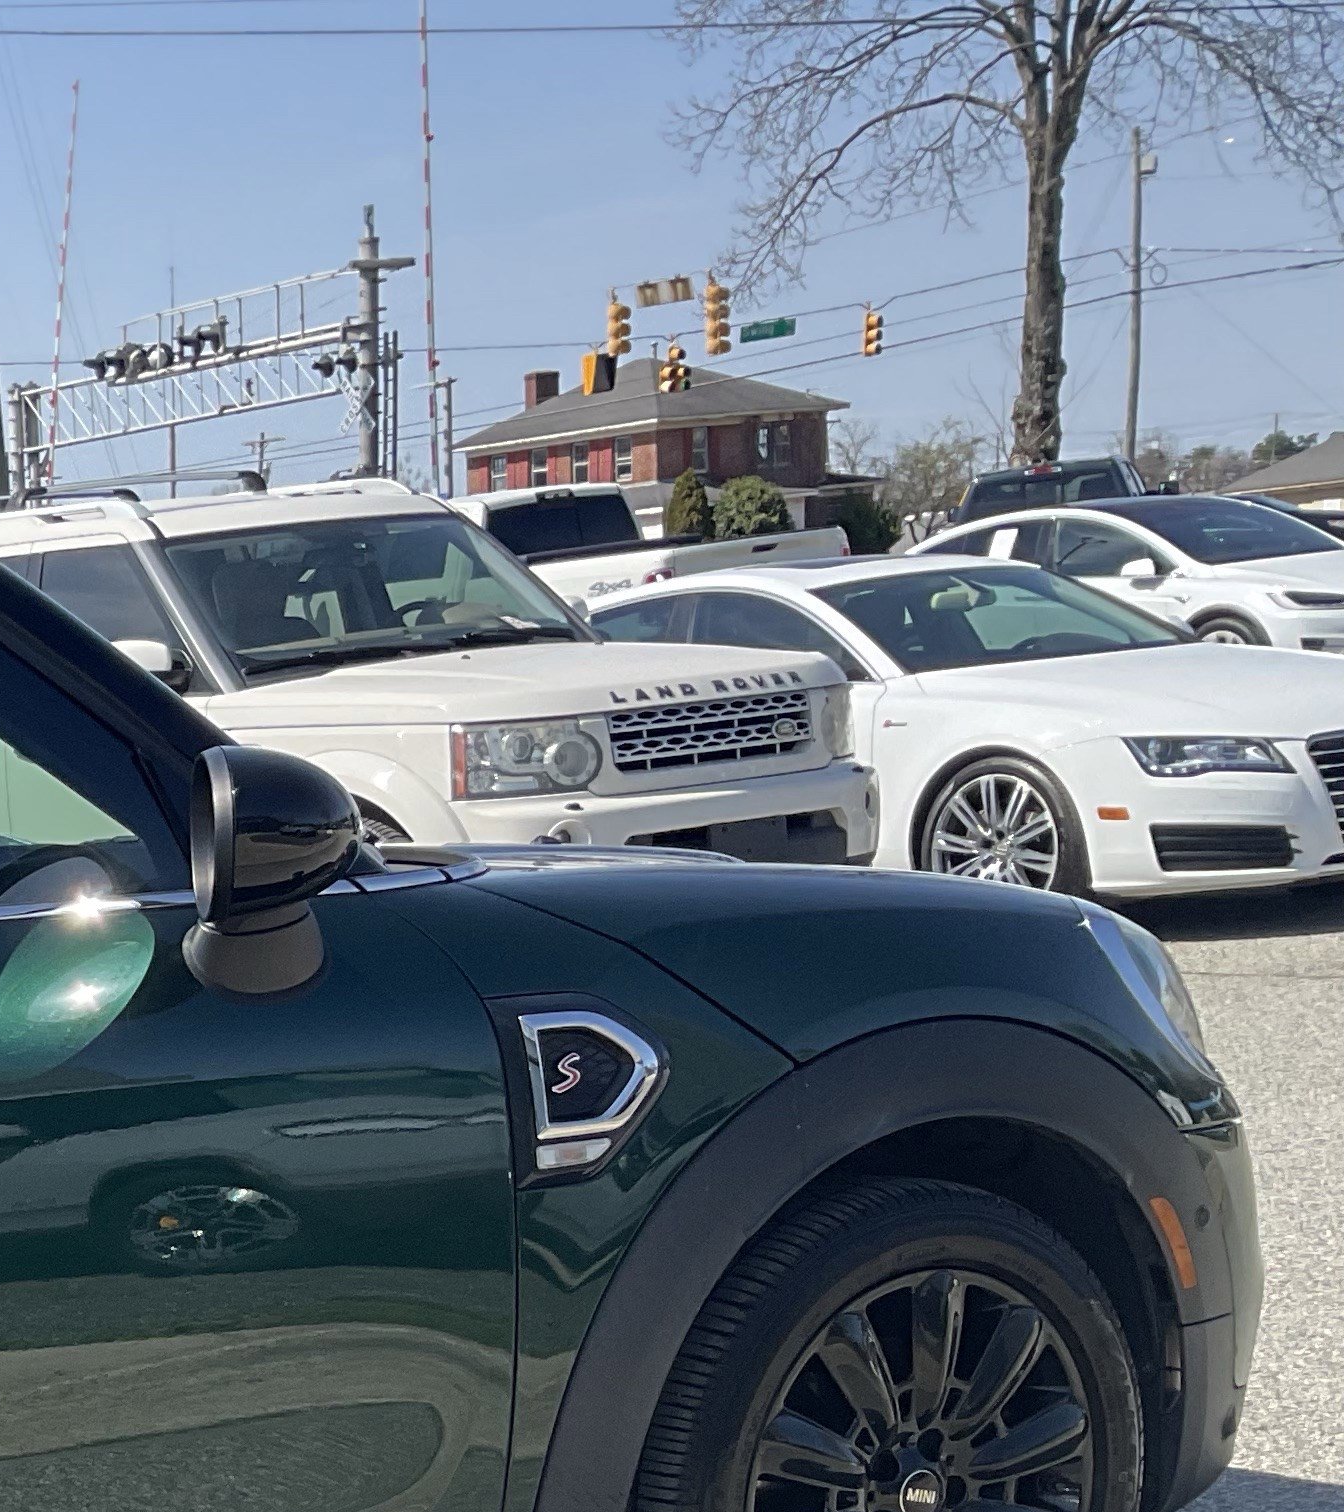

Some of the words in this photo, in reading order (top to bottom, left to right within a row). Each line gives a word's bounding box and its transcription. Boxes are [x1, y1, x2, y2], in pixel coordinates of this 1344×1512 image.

[610, 683, 698, 703] LAND
[712, 671, 802, 692] ROVER
[552, 1052, 581, 1094] S
[906, 1487, 936, 1504] MINI
